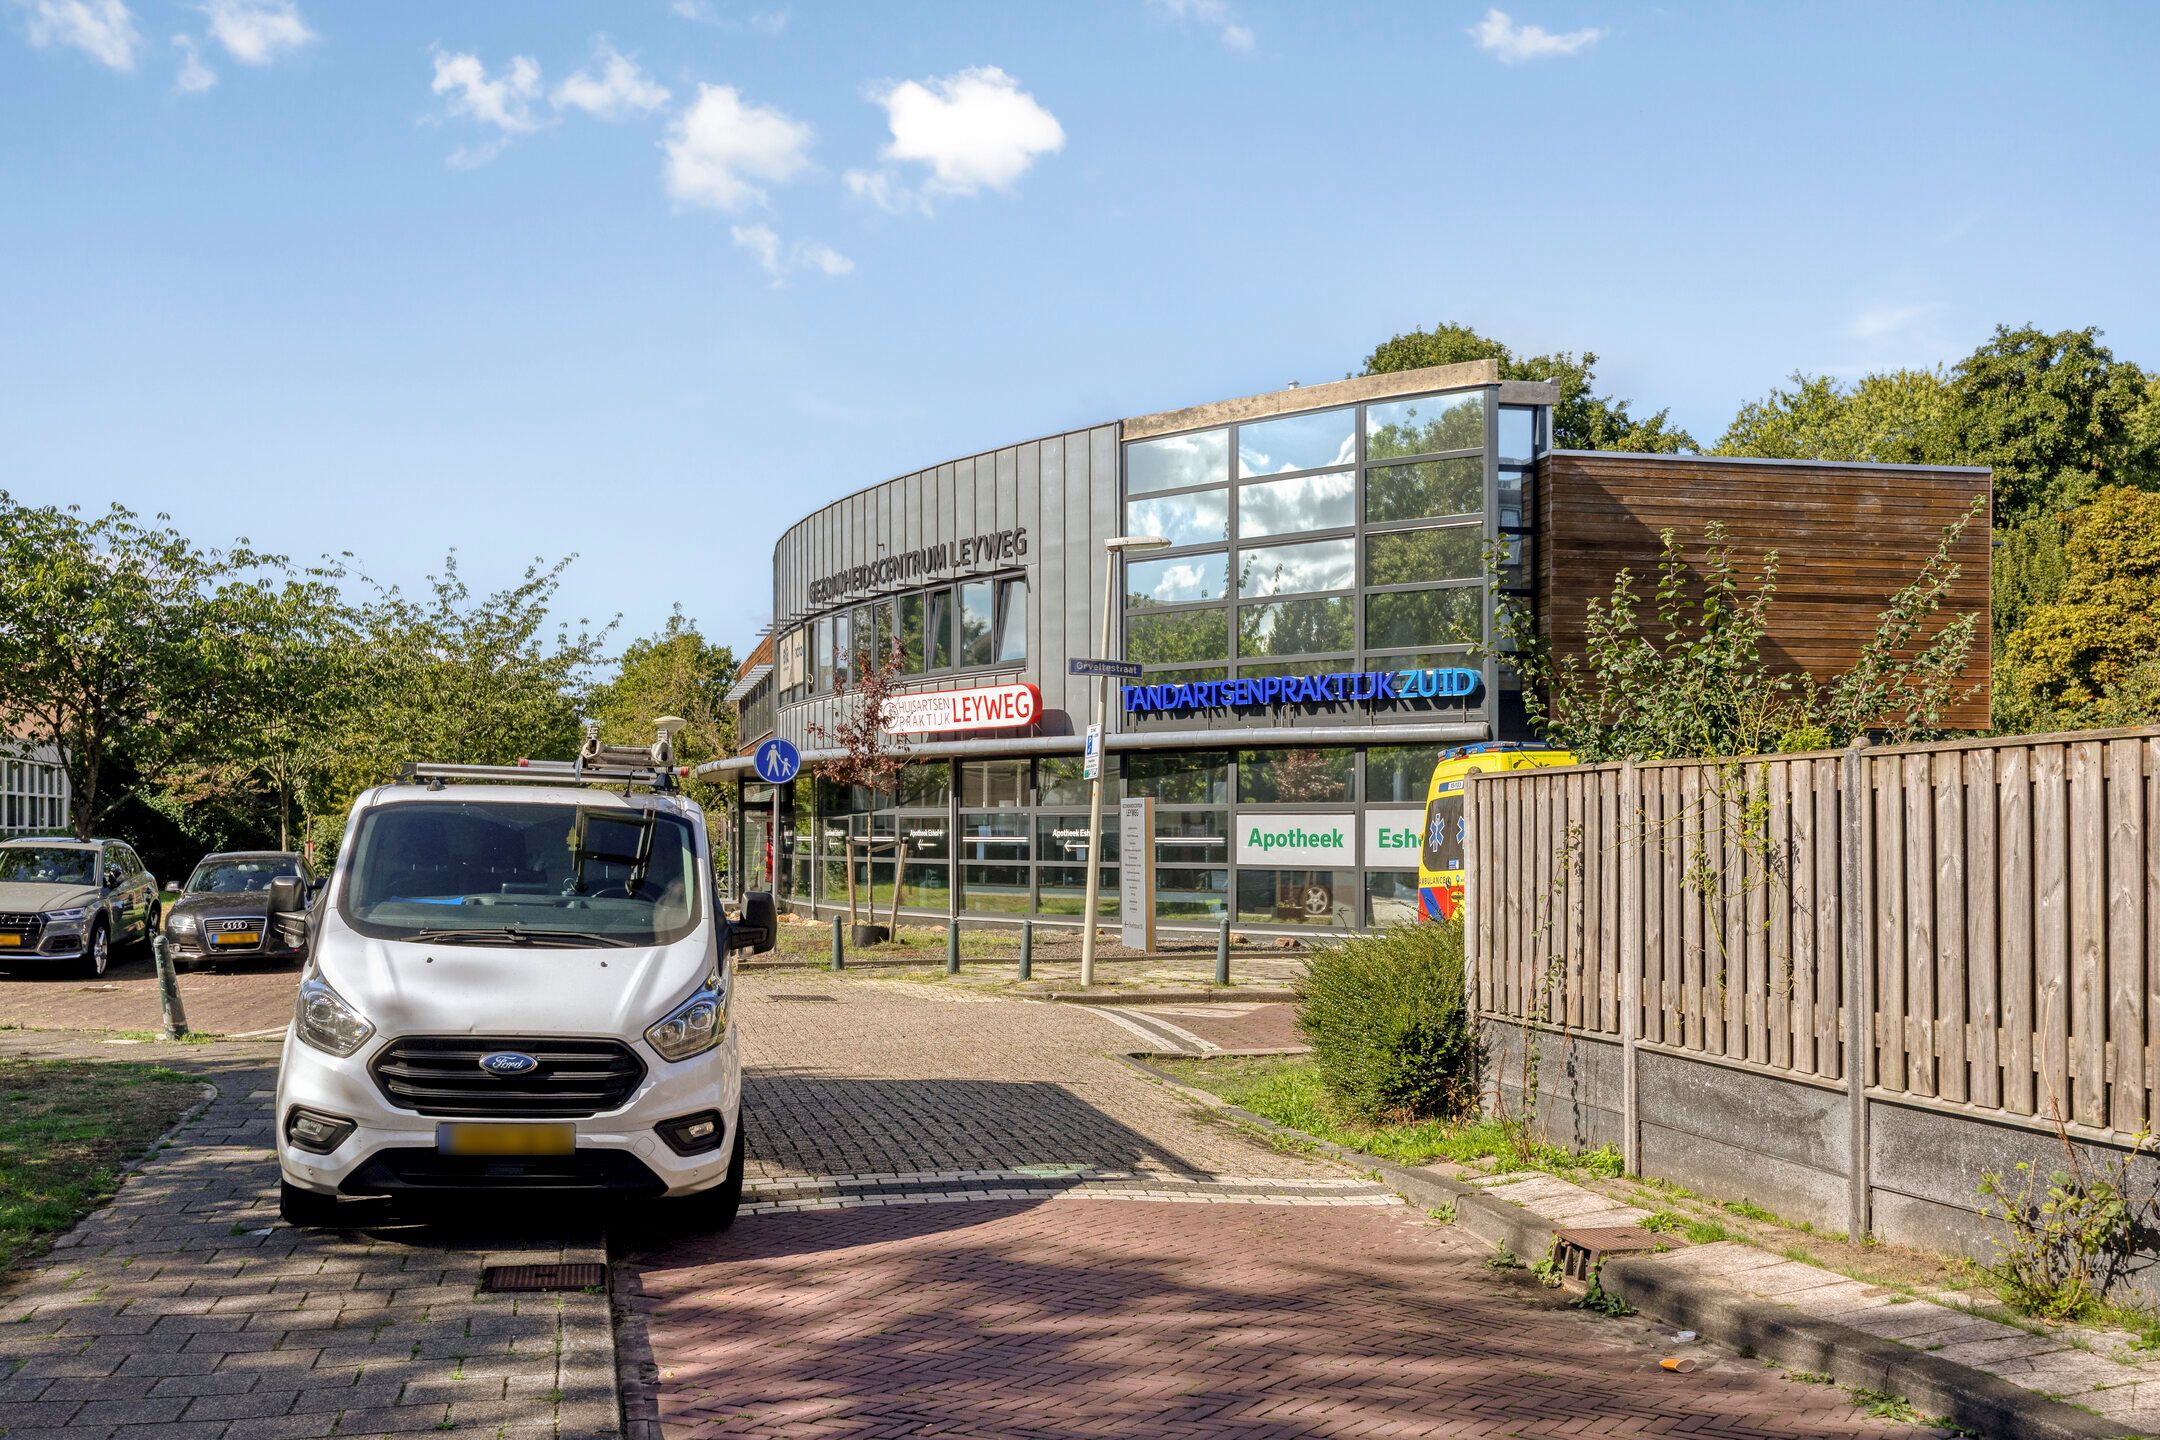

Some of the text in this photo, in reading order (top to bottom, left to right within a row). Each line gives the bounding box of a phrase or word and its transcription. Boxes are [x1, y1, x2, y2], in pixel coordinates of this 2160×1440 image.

[808, 527, 1028, 604] GEZONDHEIDSCENTRUM LEYWEG
[1120, 668, 1477, 712] TANDARTSENPRAKTIJK ZUID
[898, 697, 950, 714] HUISARTSEN
[952, 691, 1030, 723] LEYWEG
[898, 712, 951, 728] PRAKTIJK
[1052, 828, 1091, 838] Apotheek Esh
[1247, 828, 1422, 851] Apotheek Esh
[492, 1055, 524, 1069] Ford
